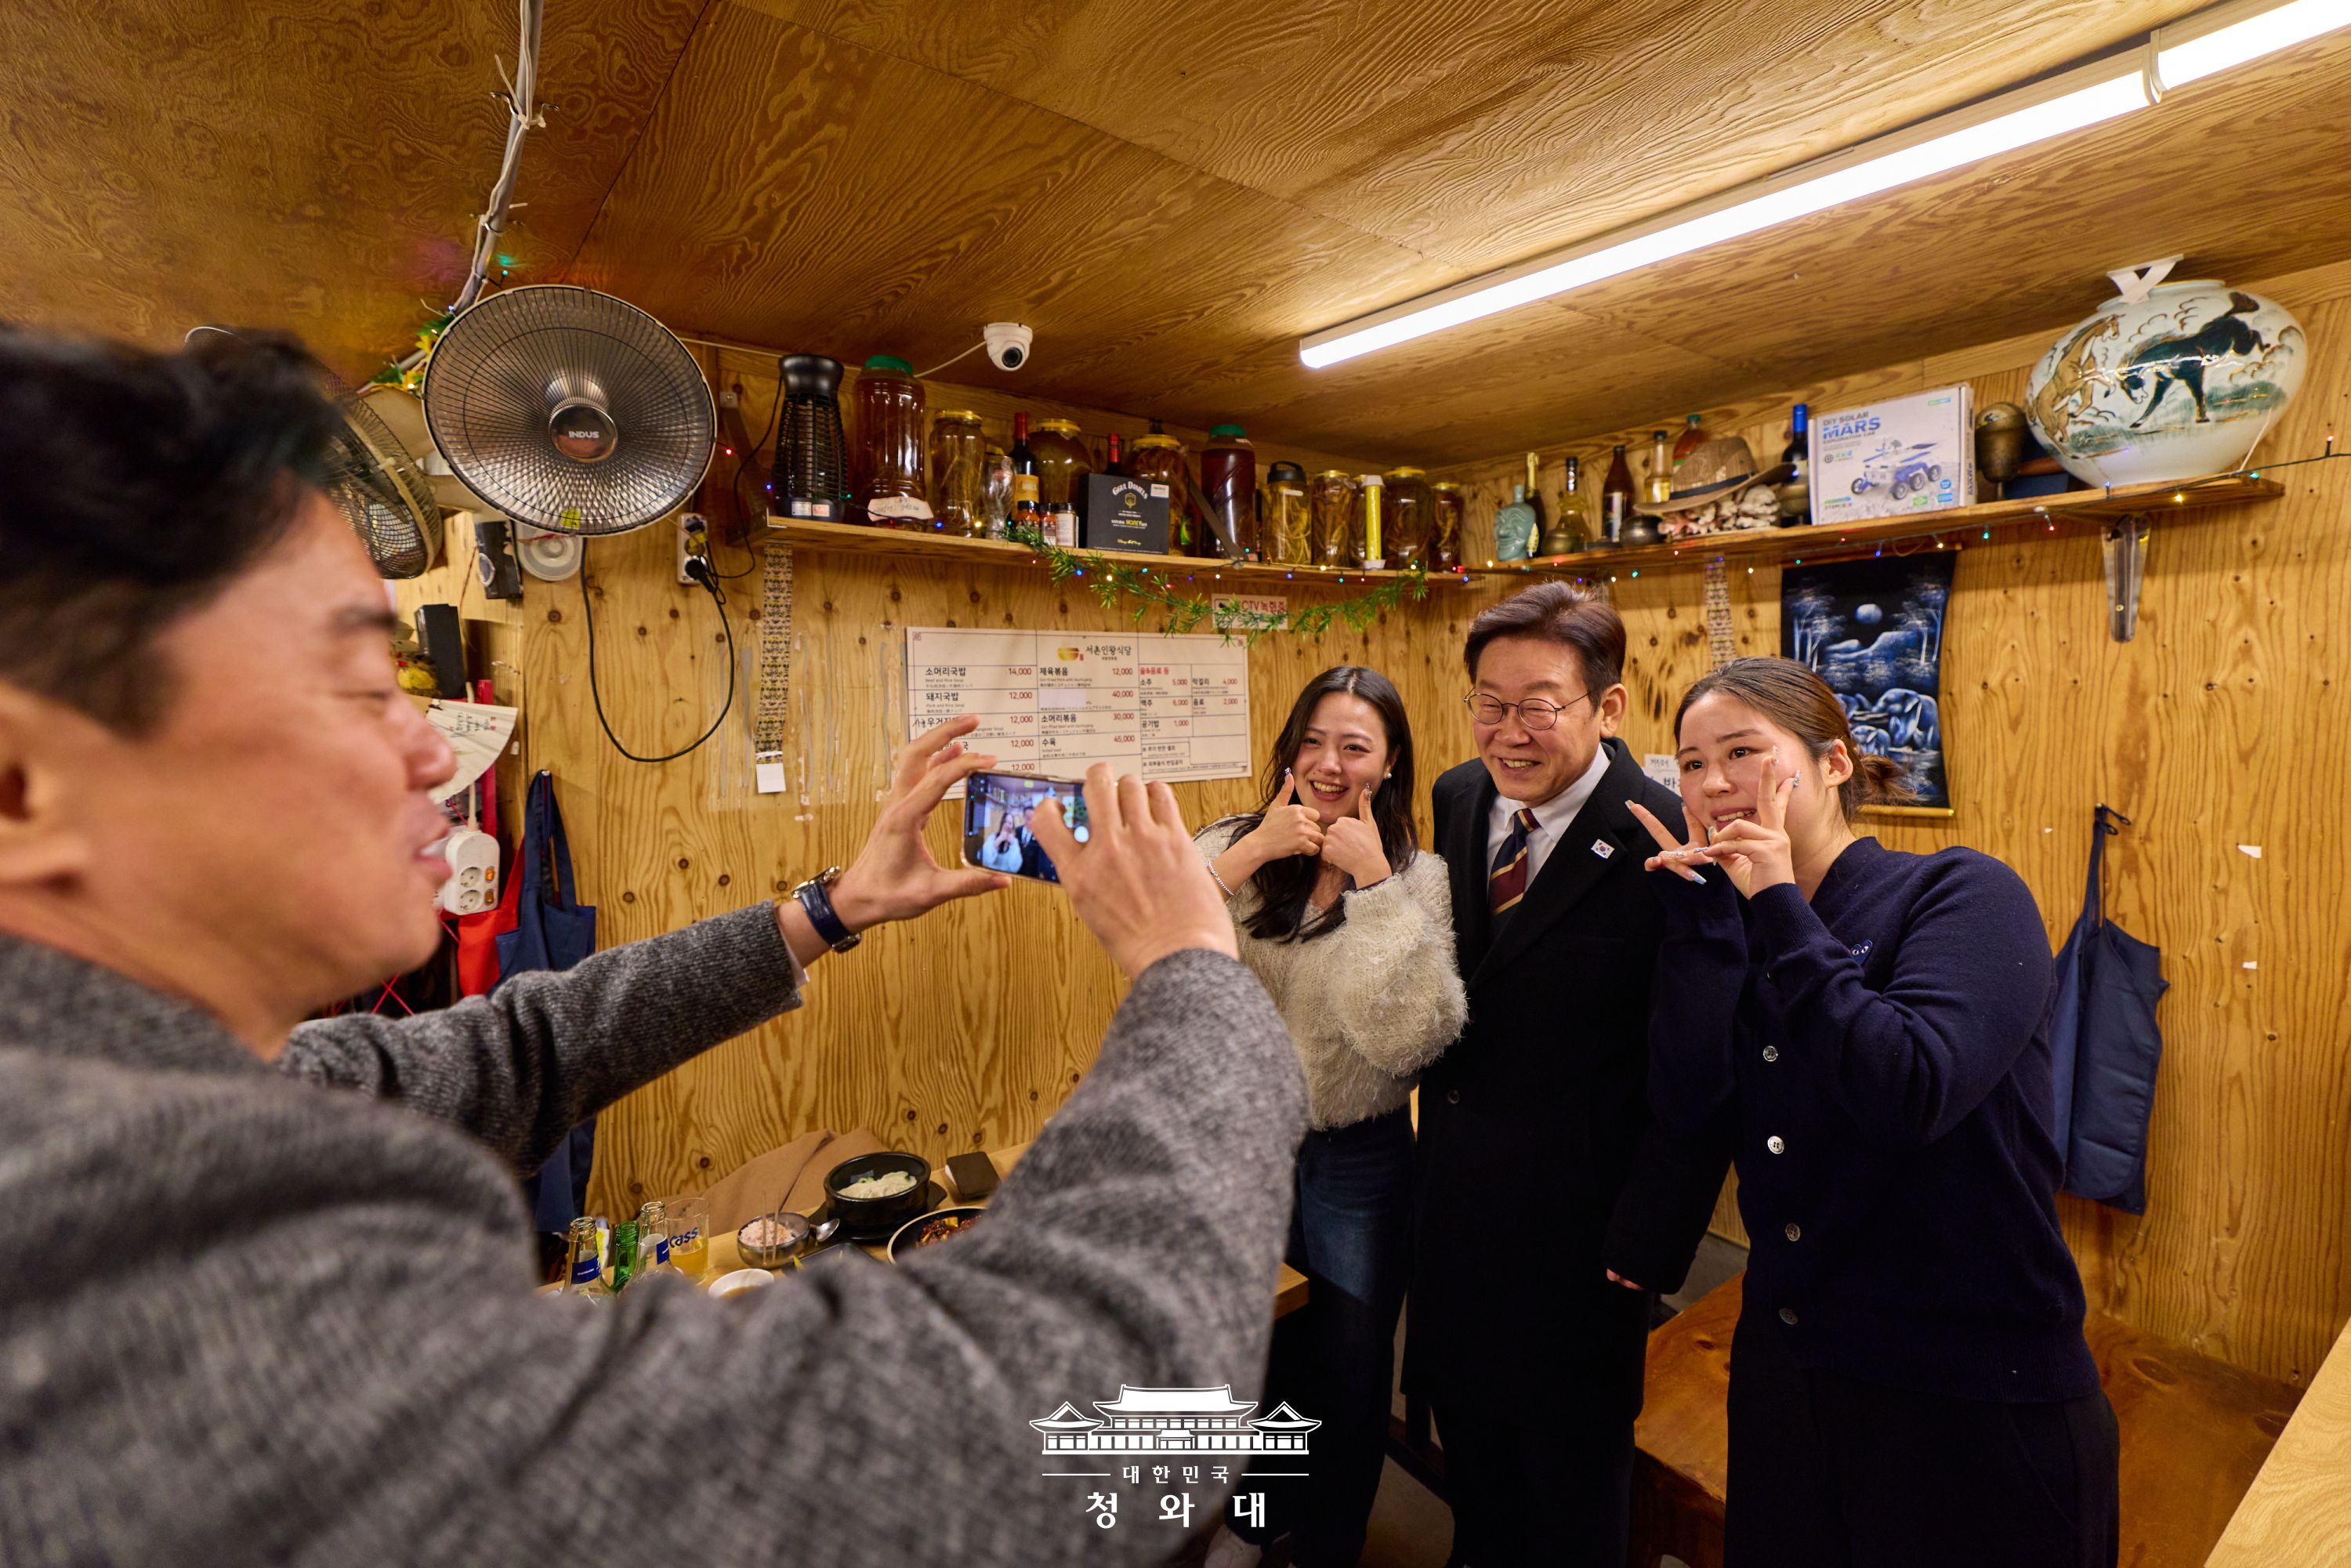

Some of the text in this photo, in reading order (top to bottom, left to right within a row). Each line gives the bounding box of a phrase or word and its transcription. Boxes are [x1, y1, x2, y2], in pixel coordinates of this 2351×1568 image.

[1839, 411, 1869, 423] SOLAR
[1823, 416, 1881, 440] MARS
[1085, 645, 1131, 656] 서촌인왕식당
[926, 667, 1031, 676] 소머리국밥 14,000
[1039, 667, 1068, 676] 제육볶음
[1140, 678, 1152, 686] 소주
[926, 691, 1032, 701] 돼지국밥 12,000
[1112, 690, 1133, 699] 40,000
[1140, 699, 1153, 708] 맥주
[1009, 715, 1033, 724] 12,000
[1041, 713, 1077, 722] 소머리볶음
[1142, 720, 1160, 729] 공기밥
[1011, 739, 1034, 748] 12,000
[1042, 737, 1056, 747] 수육
[1114, 735, 1135, 744] 45,000
